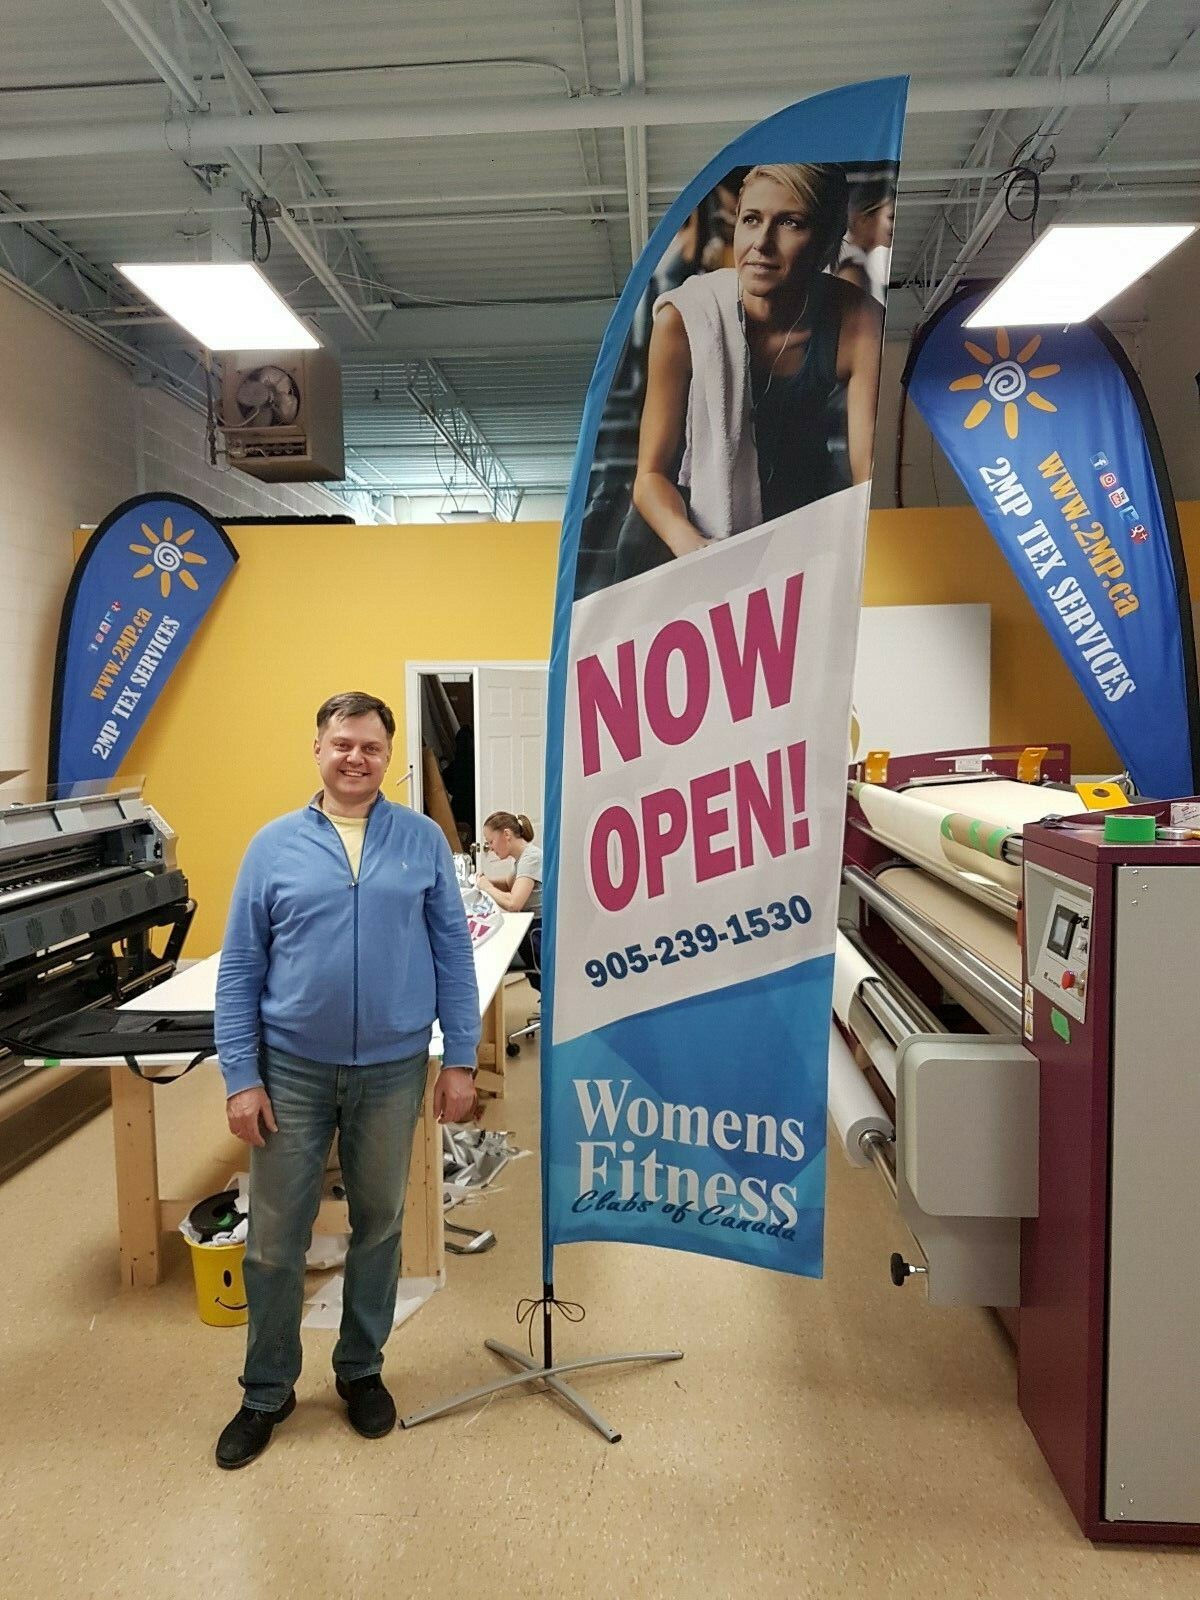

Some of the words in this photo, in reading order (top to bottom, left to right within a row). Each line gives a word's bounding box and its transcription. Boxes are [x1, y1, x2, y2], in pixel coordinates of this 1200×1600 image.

[979, 457, 1033, 517] 2MP
[1017, 519, 1067, 580] TEX
[1046, 576, 1137, 702] SERVICES
[1037, 450, 1140, 618] www.2MP.ca
[92, 719, 121, 761] 2MP
[111, 685, 142, 720] TEX
[130, 615, 181, 689] SERVICES
[576, 571, 805, 777] NOW
[589, 740, 811, 913] OPEN!
[584, 894, 812, 988] 905-239-1530
[572, 1078, 805, 1162] Womens
[575, 1140, 799, 1230] Fitness
[661, 1200, 696, 1224] of
[698, 1205, 796, 1242] Canada
